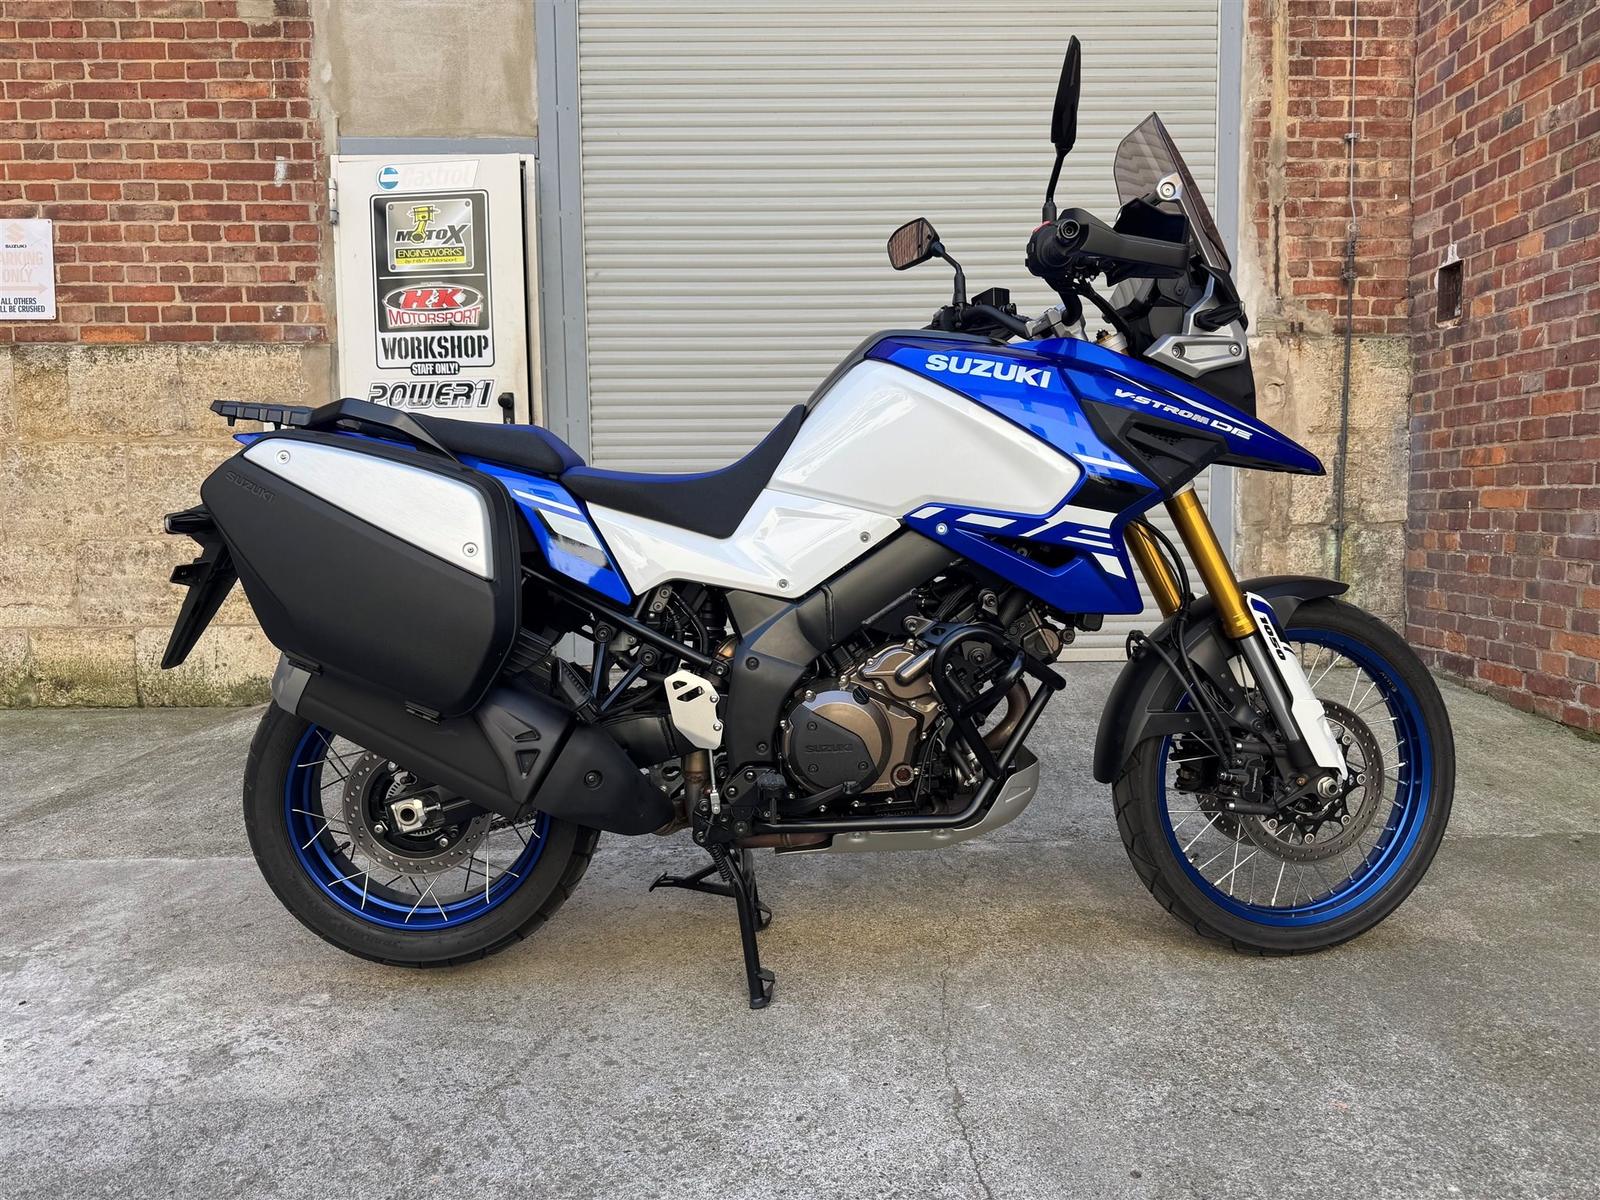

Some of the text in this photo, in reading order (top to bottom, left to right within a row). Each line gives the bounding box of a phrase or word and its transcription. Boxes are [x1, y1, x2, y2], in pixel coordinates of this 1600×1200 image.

[397, 247, 463, 258] ENGINEWORKS
[2, 268, 32, 282] ONLY
[1, 297, 37, 305] ALL OTHERS
[402, 288, 464, 308] H&K
[9, 305, 16, 313] BE
[18, 305, 46, 313] CRUSHED
[388, 307, 481, 326] MOTORSPORT
[381, 335, 489, 360] WORKSHOP
[412, 363, 459, 375] STAFF ONLY!
[925, 354, 1051, 389] SUZUKI
[369, 381, 493, 408] POWER1
[1114, 388, 1253, 440] V-STROM DE
[224, 470, 276, 503] SUZUKI
[1259, 615, 1286, 661] 1050
[804, 743, 853, 753] SUZUKI
